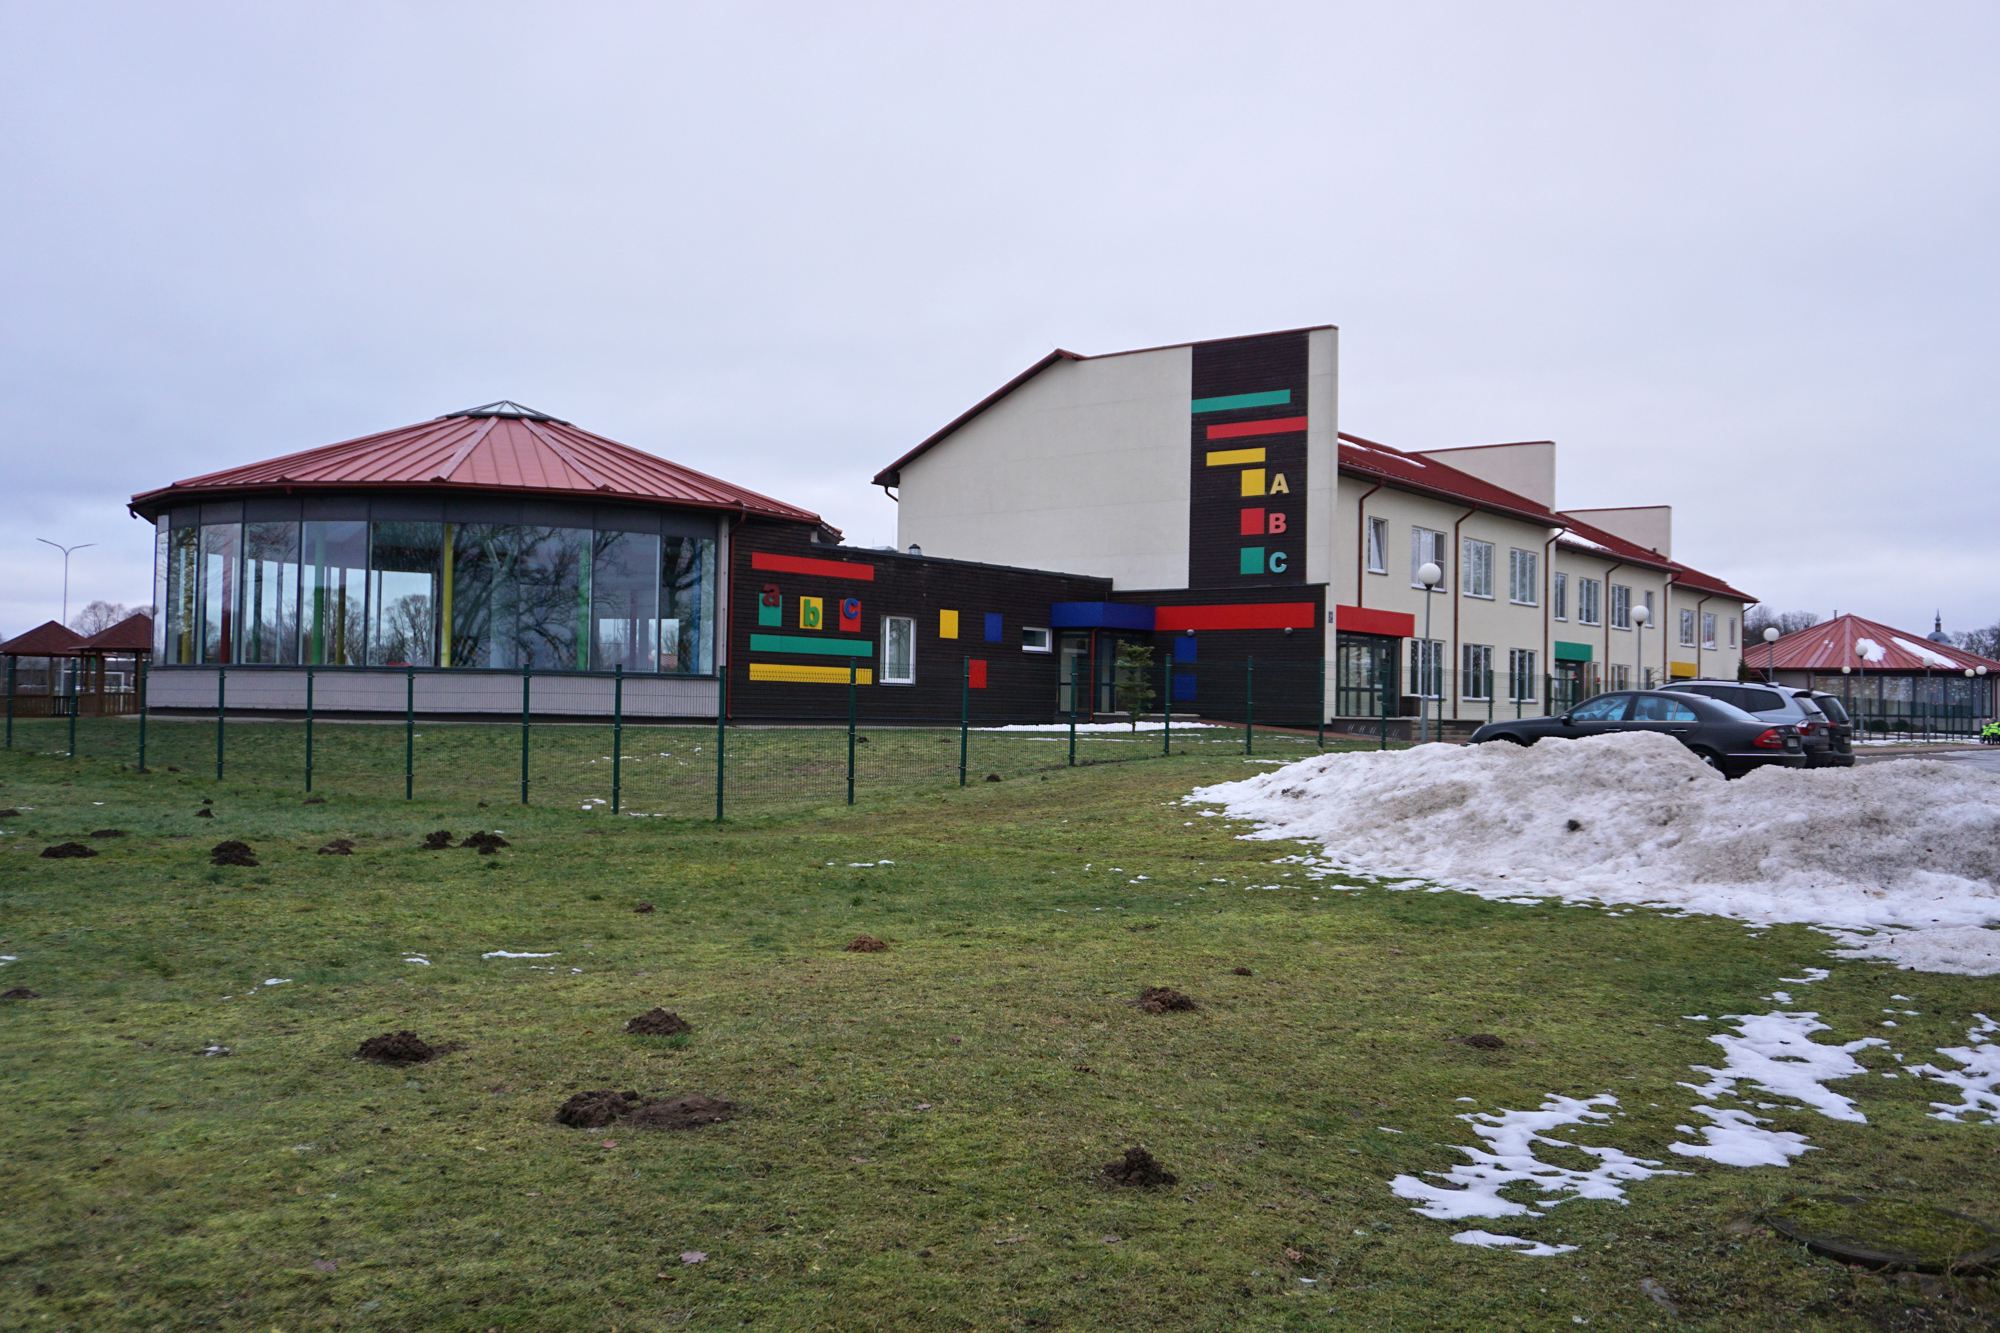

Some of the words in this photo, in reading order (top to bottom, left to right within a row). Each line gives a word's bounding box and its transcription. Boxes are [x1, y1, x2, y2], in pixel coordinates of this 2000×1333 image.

[1269, 473, 1290, 495] A
[1269, 512, 1287, 534] B
[1269, 551, 1288, 573] C
[762, 584, 781, 607] a
[804, 598, 820, 627] b
[843, 597, 859, 619] c
